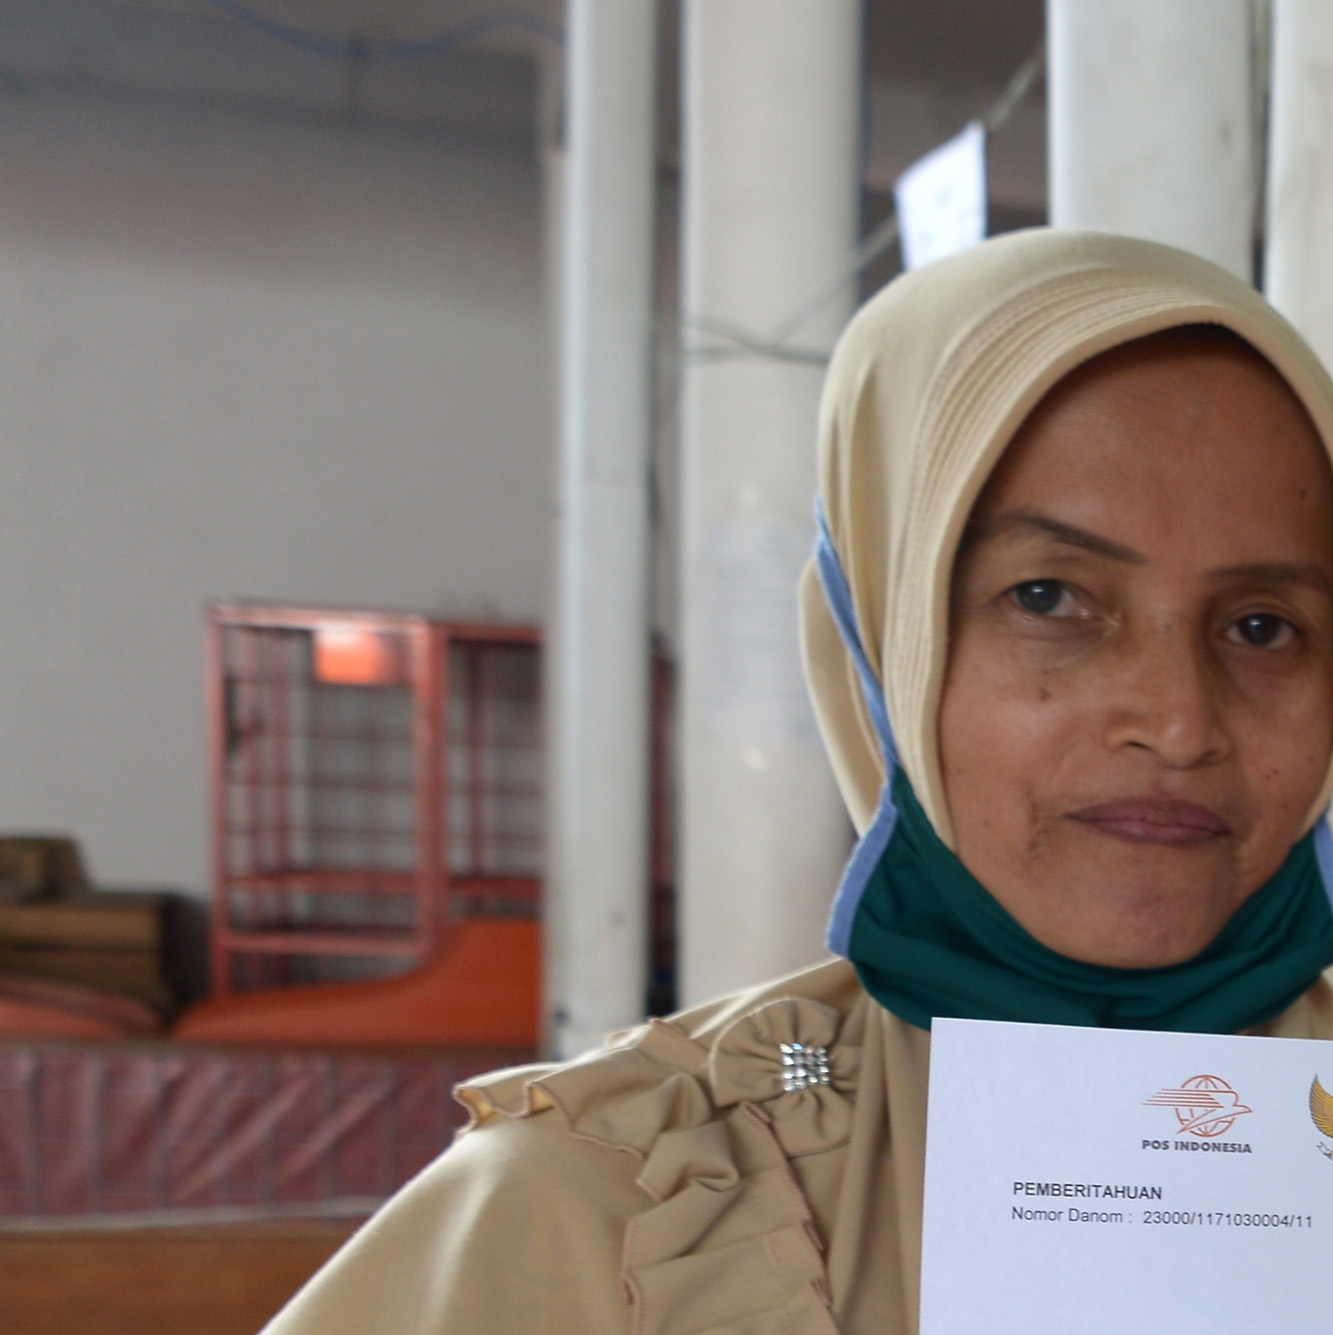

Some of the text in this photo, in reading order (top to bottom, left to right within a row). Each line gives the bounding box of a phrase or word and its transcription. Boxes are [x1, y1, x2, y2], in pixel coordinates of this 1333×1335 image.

[1142, 1139, 1252, 1153] POS INDONESIA
[1013, 1181, 1162, 1200] PEMBERITAHUAN
[1012, 1207, 1312, 1228] Nomor Danom 23000/1171030004/11
